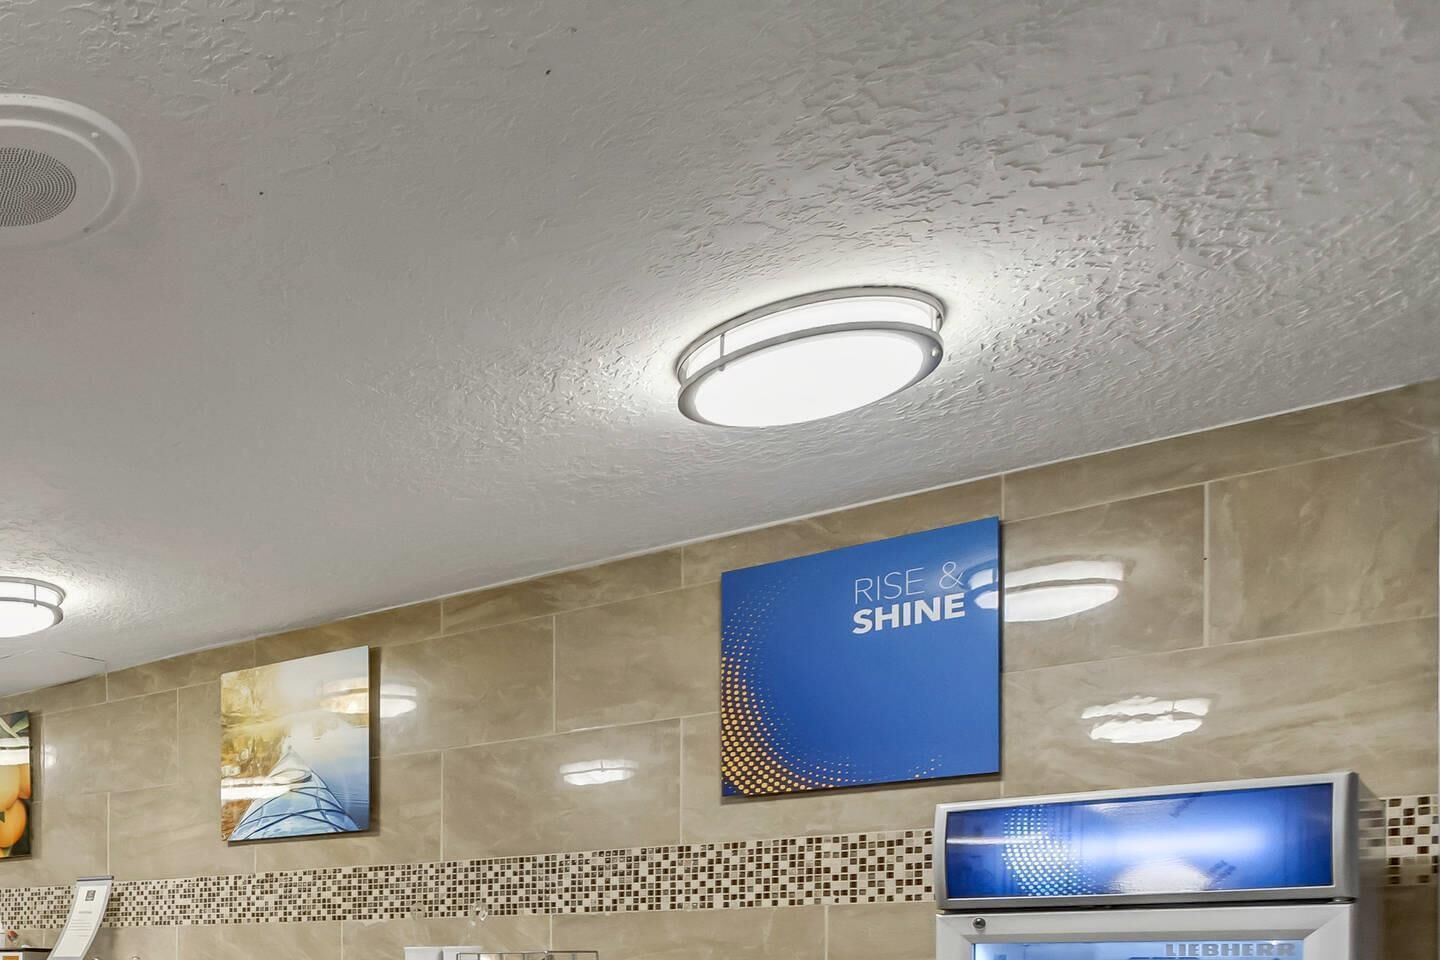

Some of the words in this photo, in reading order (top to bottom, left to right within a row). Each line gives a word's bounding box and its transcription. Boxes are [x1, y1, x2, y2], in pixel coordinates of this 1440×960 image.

[854, 566, 926, 605] RISE
[938, 560, 965, 590] &
[851, 592, 966, 635] SHINE
[1165, 943, 1296, 957] LIEBHERR
